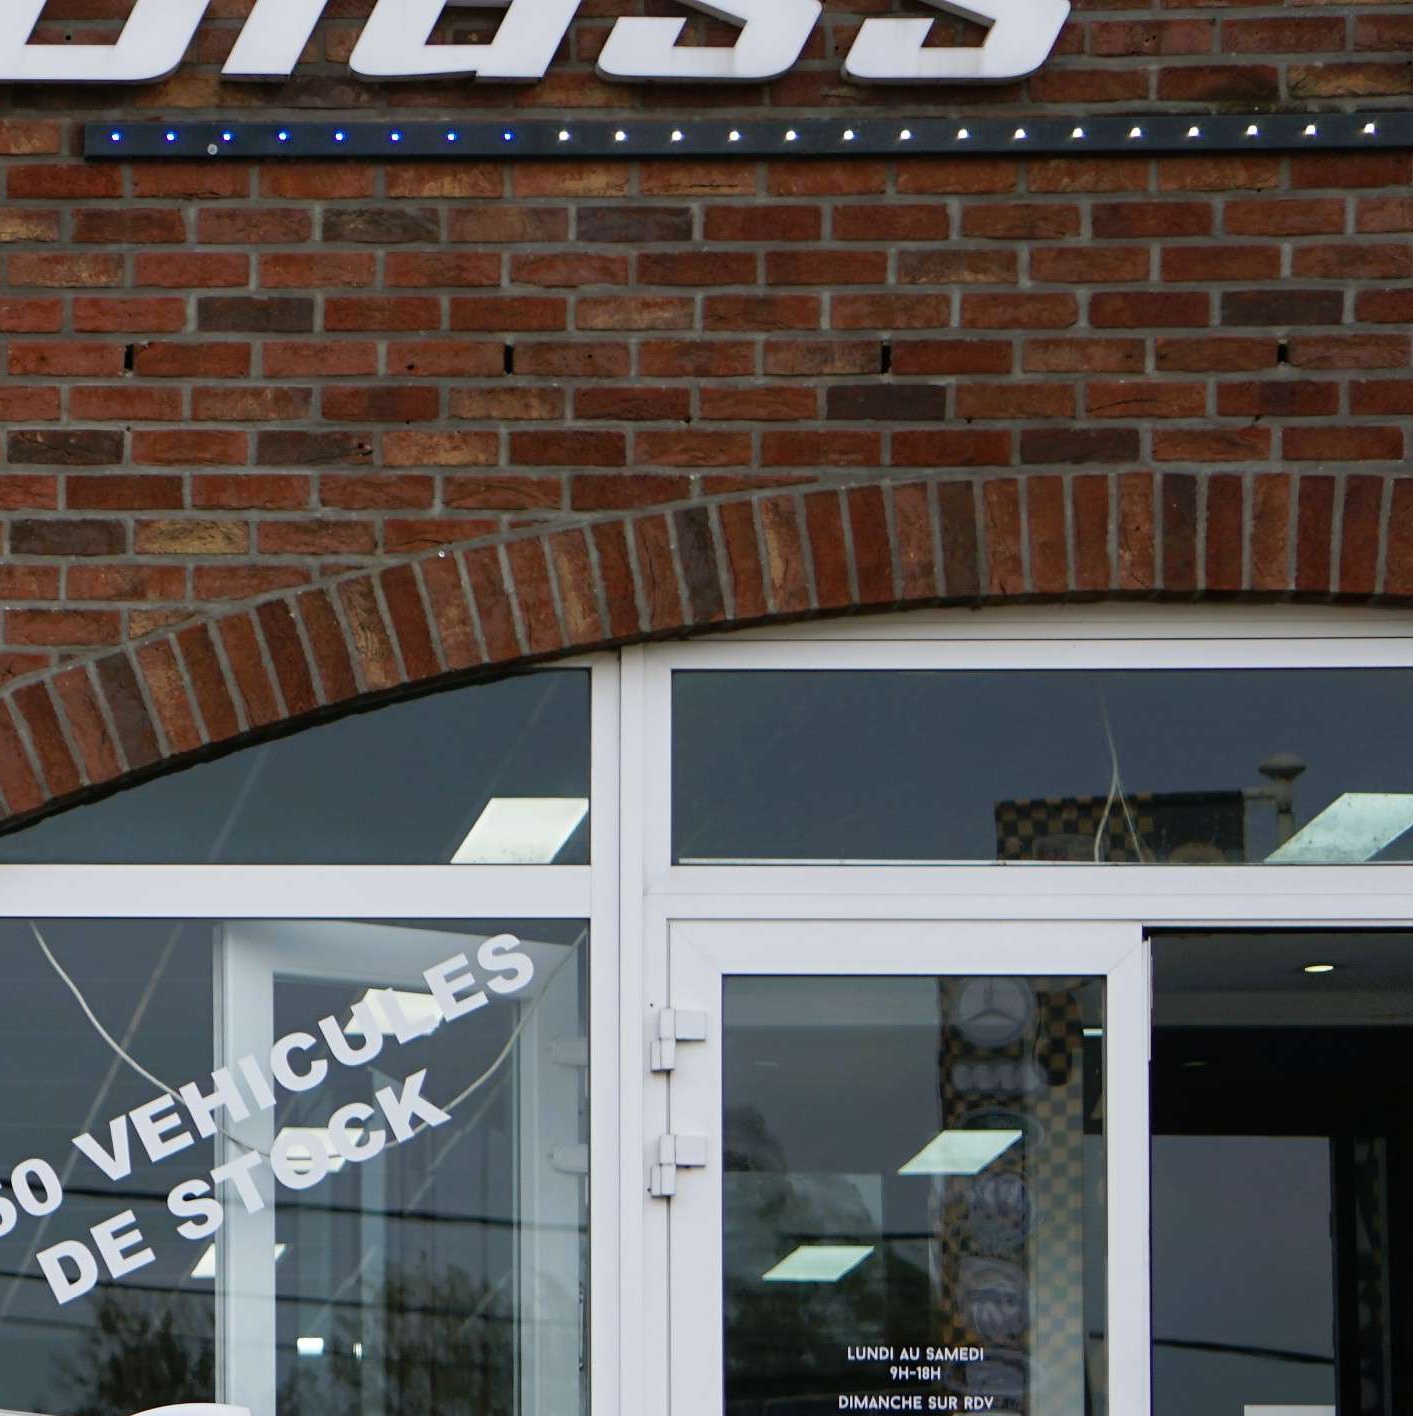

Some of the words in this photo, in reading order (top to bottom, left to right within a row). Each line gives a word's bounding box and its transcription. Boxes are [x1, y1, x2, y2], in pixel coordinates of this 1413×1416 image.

[71, 932, 535, 1182] VEHICULES
[35, 1208, 157, 1305] DE
[166, 1068, 452, 1240] STOCK
[847, 1346, 894, 1361] LUNDI
[899, 1347, 920, 1361] AU
[926, 1347, 984, 1361] SAMEDI
[889, 1366, 941, 1380] 9H-18H
[838, 1395, 922, 1409] DIMANCHE
[928, 1396, 958, 1410] SUR
[964, 1396, 994, 1410] RDV
